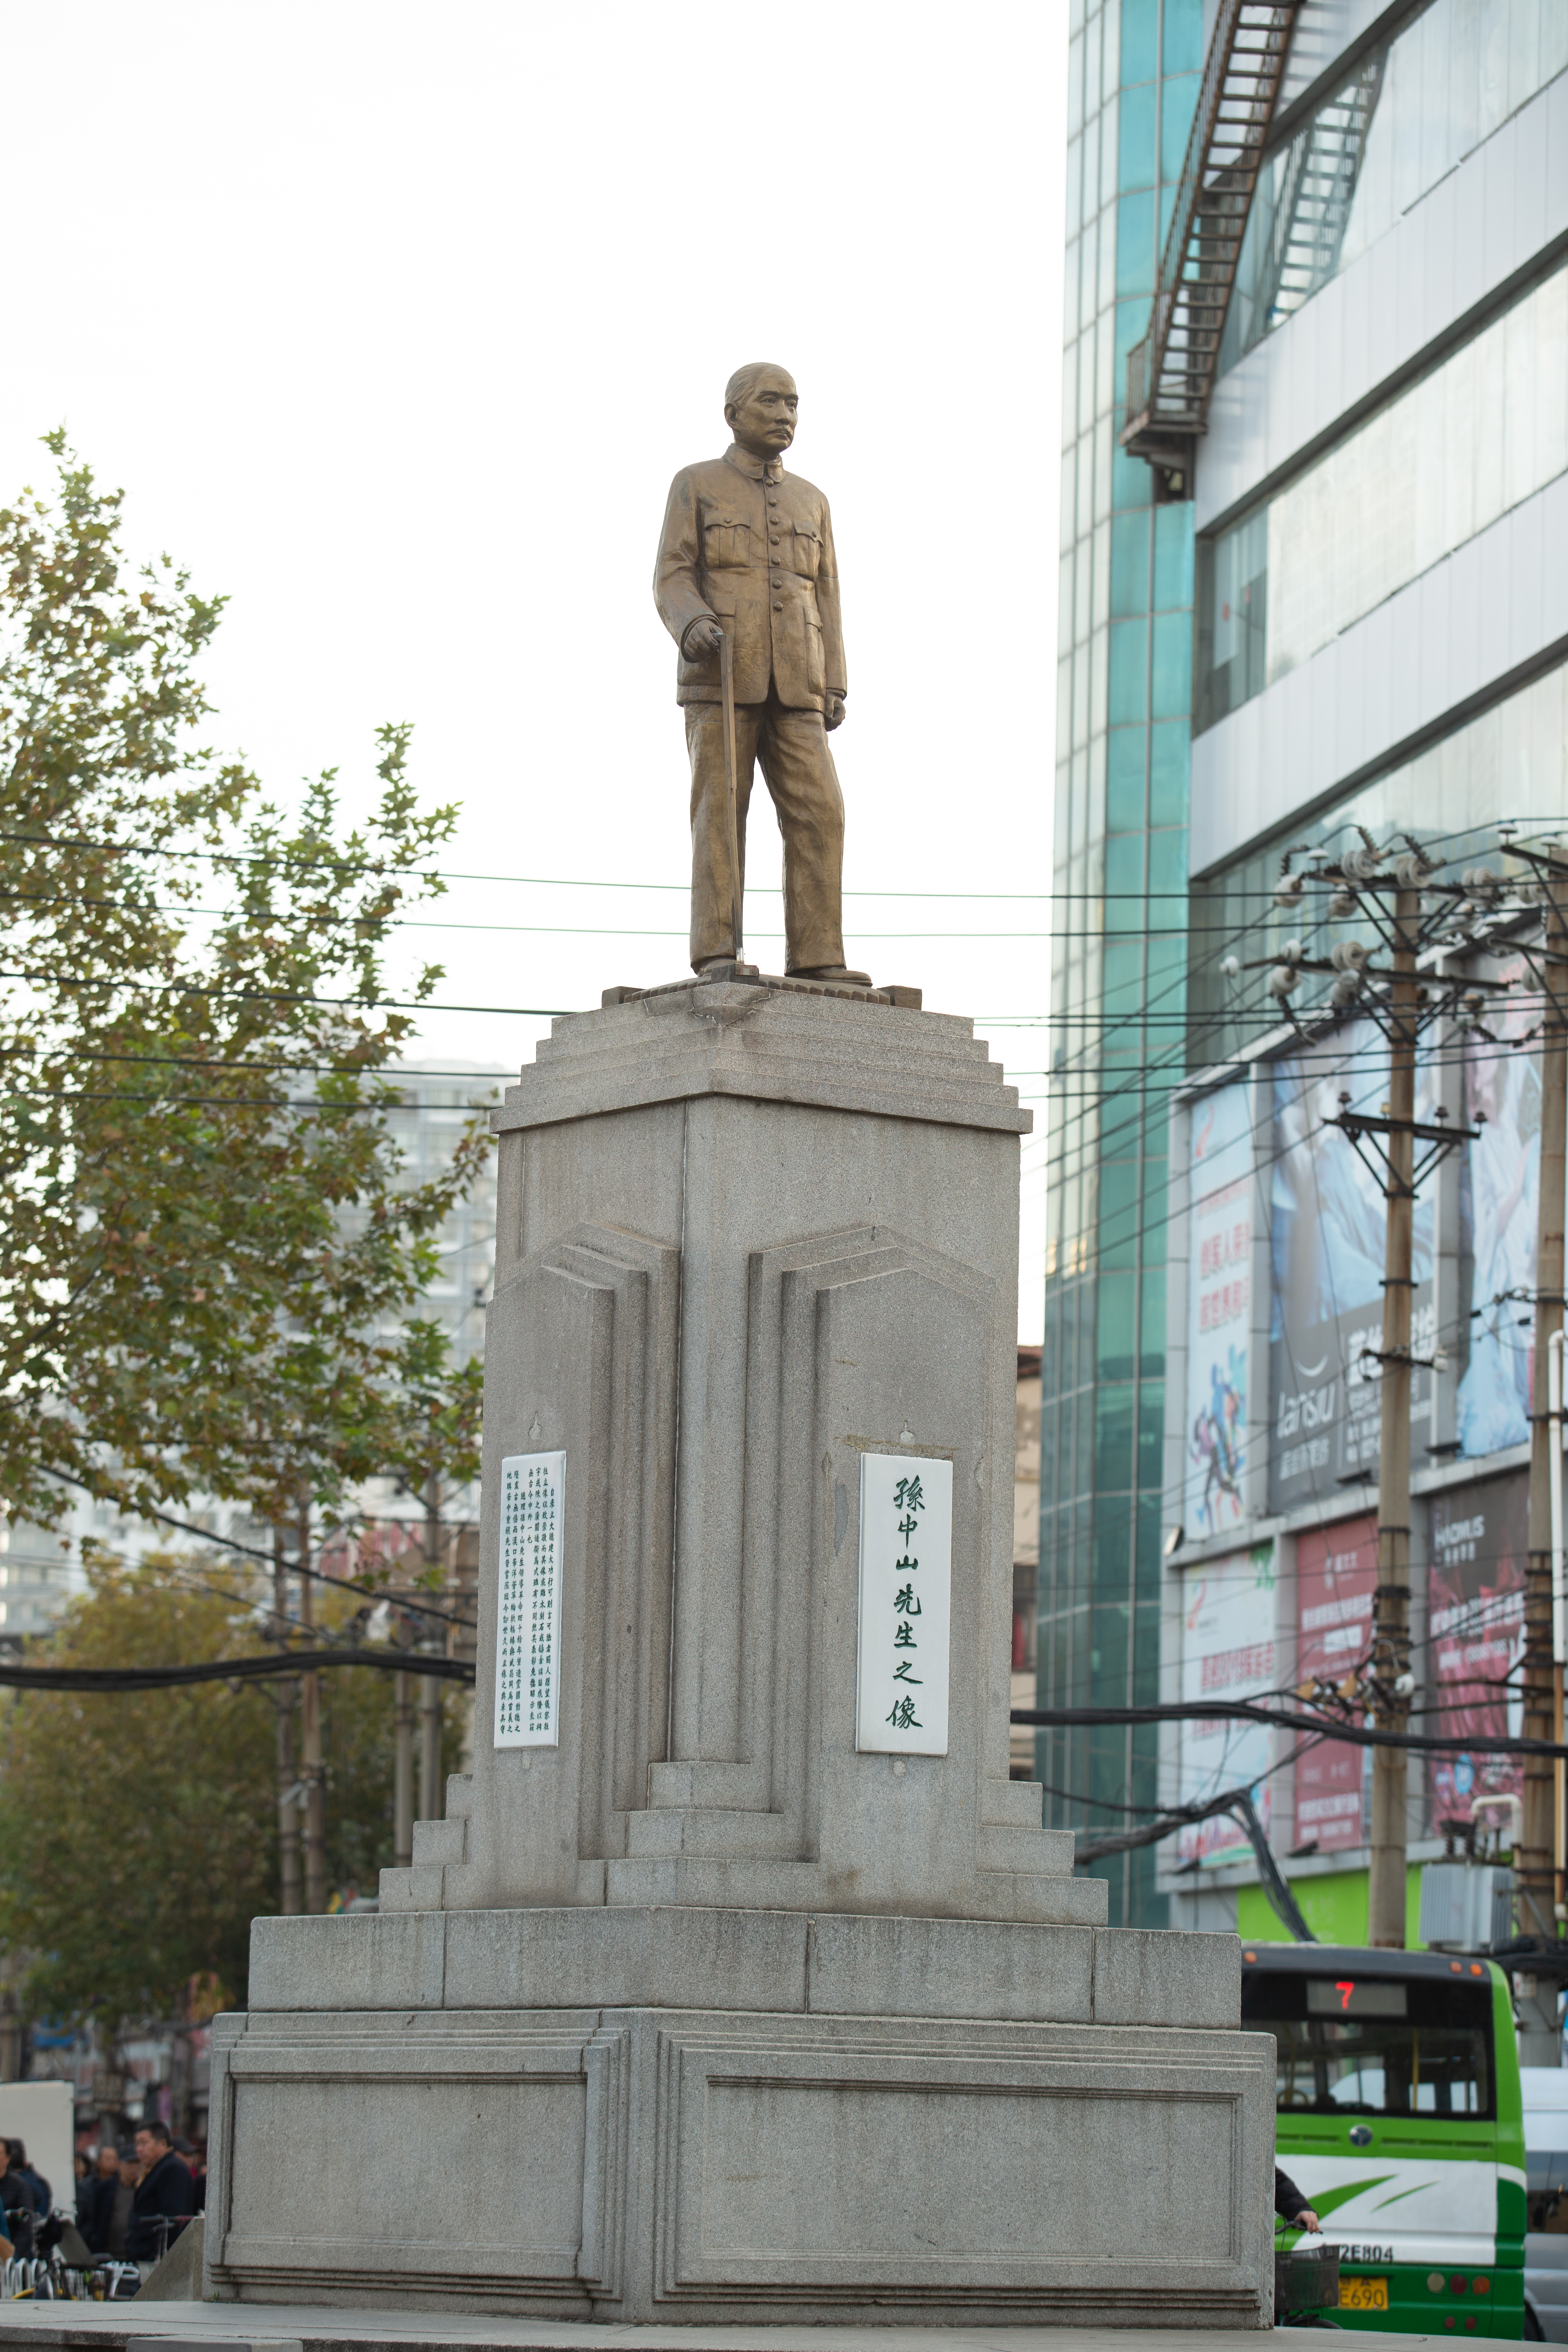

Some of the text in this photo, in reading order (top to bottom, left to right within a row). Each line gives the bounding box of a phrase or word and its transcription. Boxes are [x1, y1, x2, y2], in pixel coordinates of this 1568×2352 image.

[886, 1474, 925, 1729] 孫中山先生之像
[1336, 1982, 1354, 2010] 7
